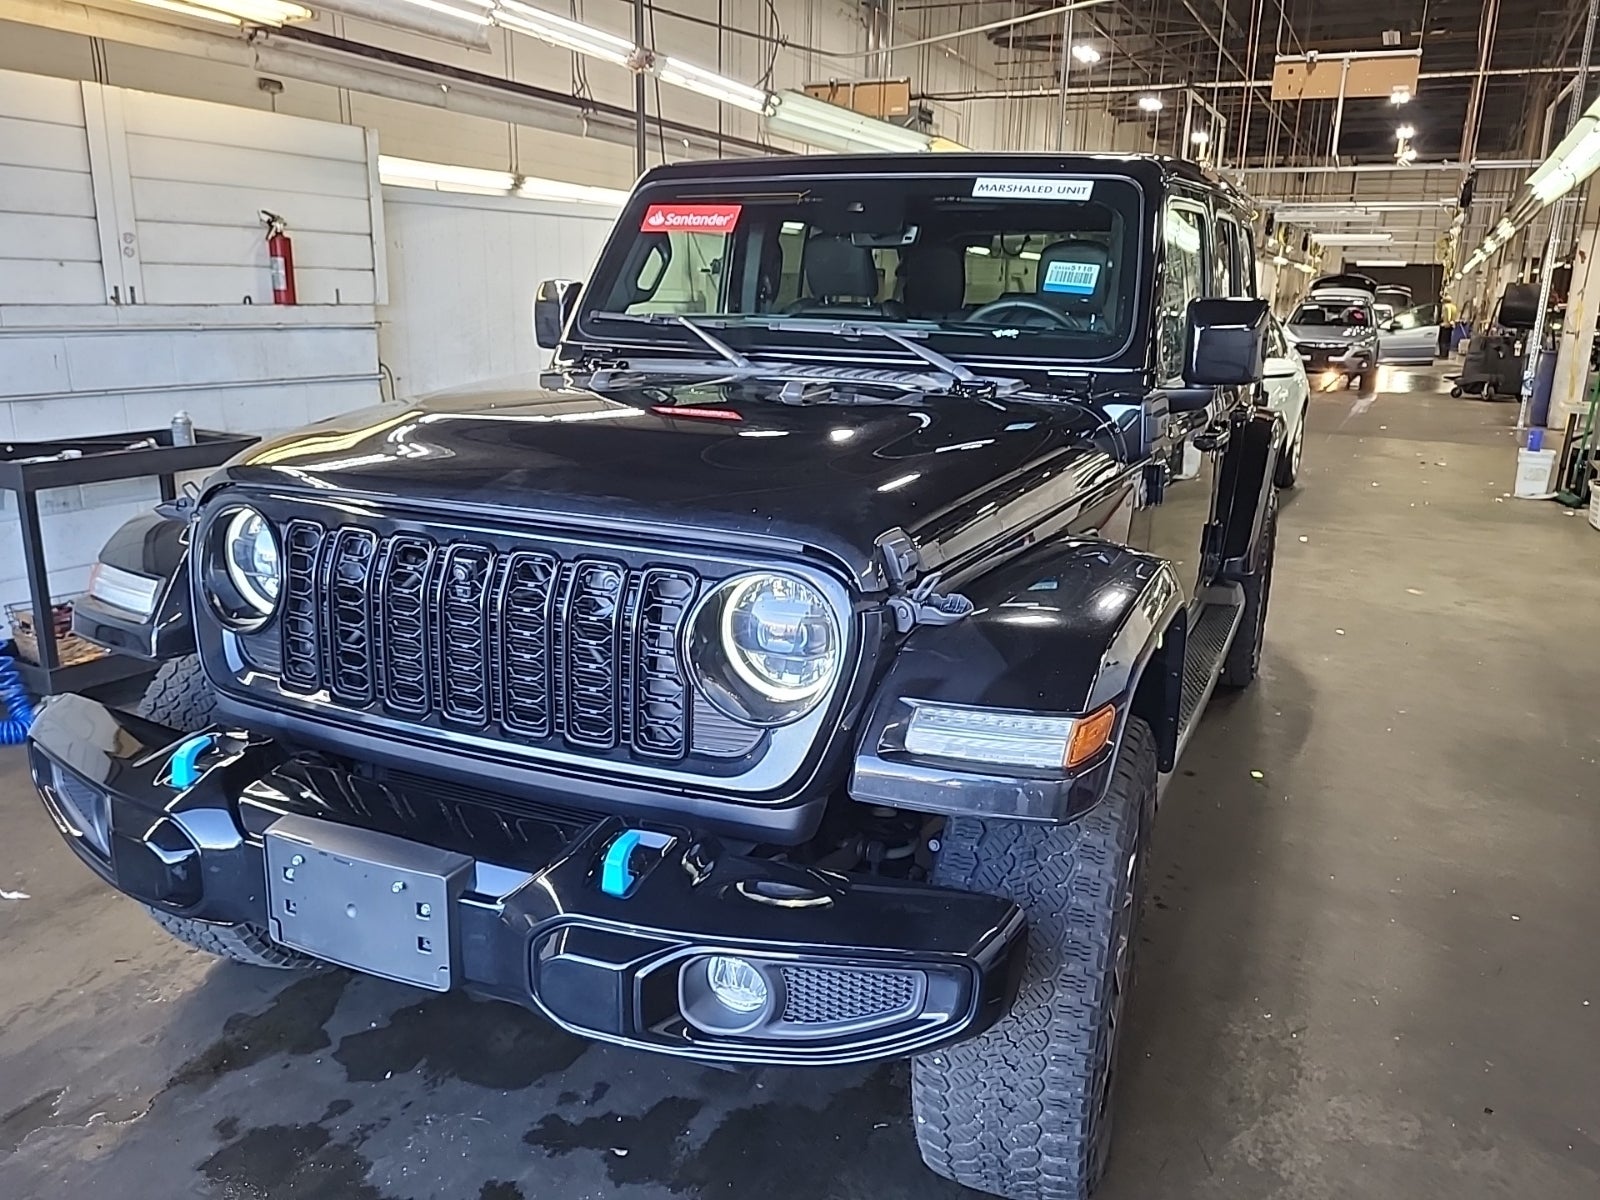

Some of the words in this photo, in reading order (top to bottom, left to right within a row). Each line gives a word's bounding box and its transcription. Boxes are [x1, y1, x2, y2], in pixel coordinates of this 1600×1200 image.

[978, 184, 1053, 194] MARSHALED
[1057, 186, 1088, 195] UNIT
[664, 213, 730, 226] Santander
